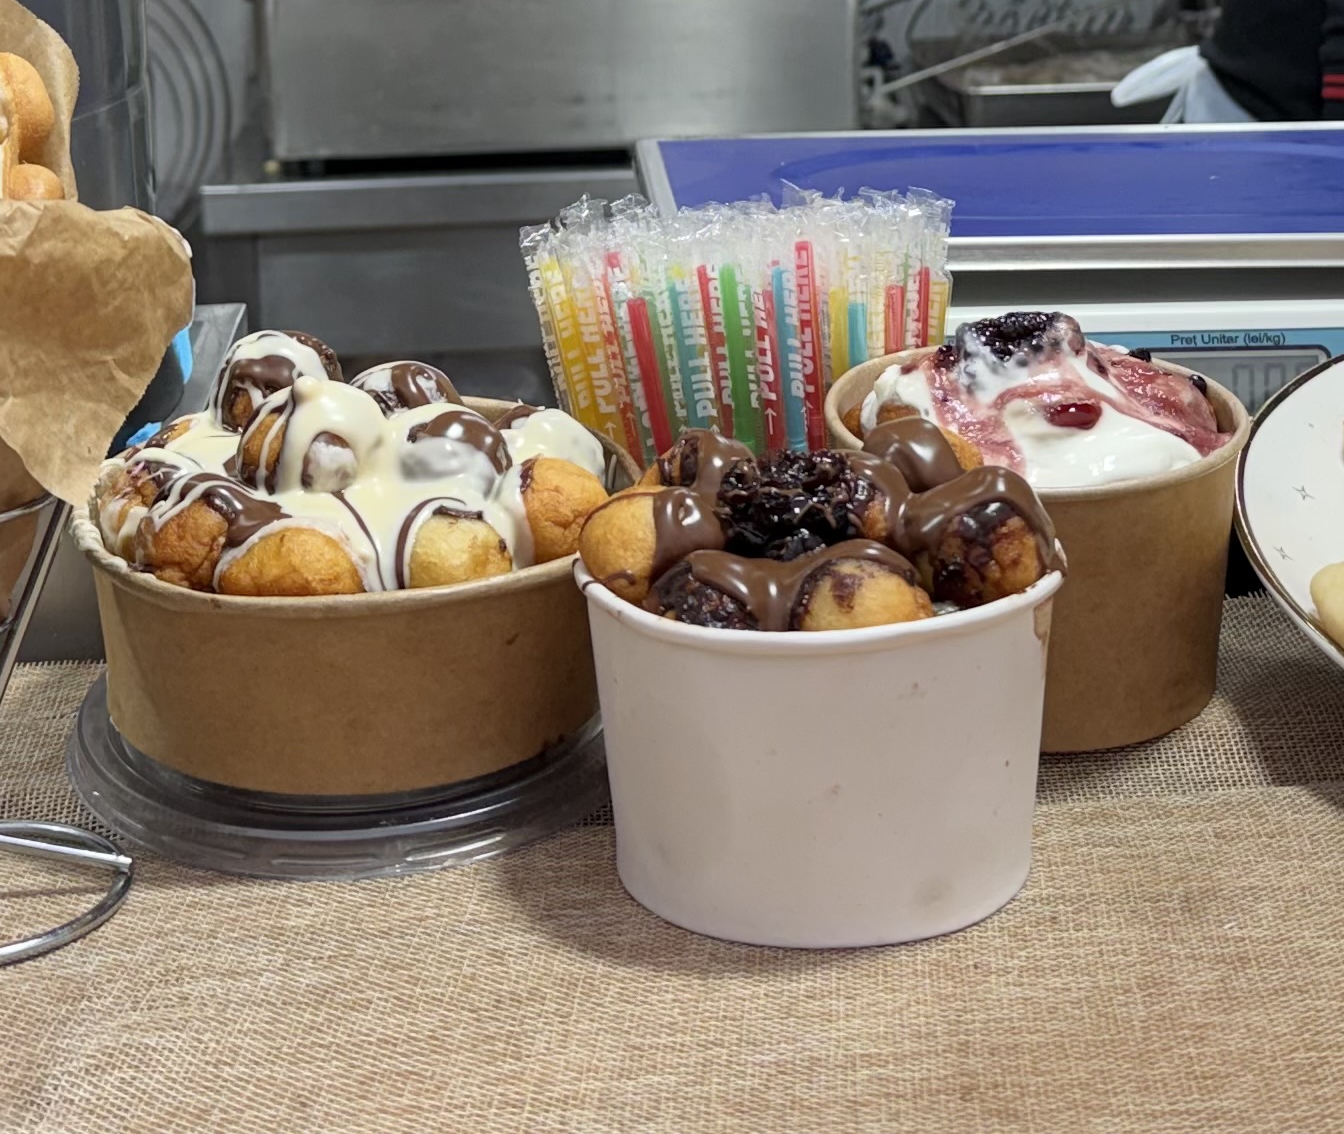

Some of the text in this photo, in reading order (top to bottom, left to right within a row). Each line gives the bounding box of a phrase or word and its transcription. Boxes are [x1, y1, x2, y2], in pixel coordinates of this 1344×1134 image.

[755, 335, 777, 400] PULL
[1201, 332, 1240, 345] Unitar
[1243, 331, 1287, 346] (lei/kg)
[588, 347, 617, 414] PULL
[688, 352, 718, 417] PULL
